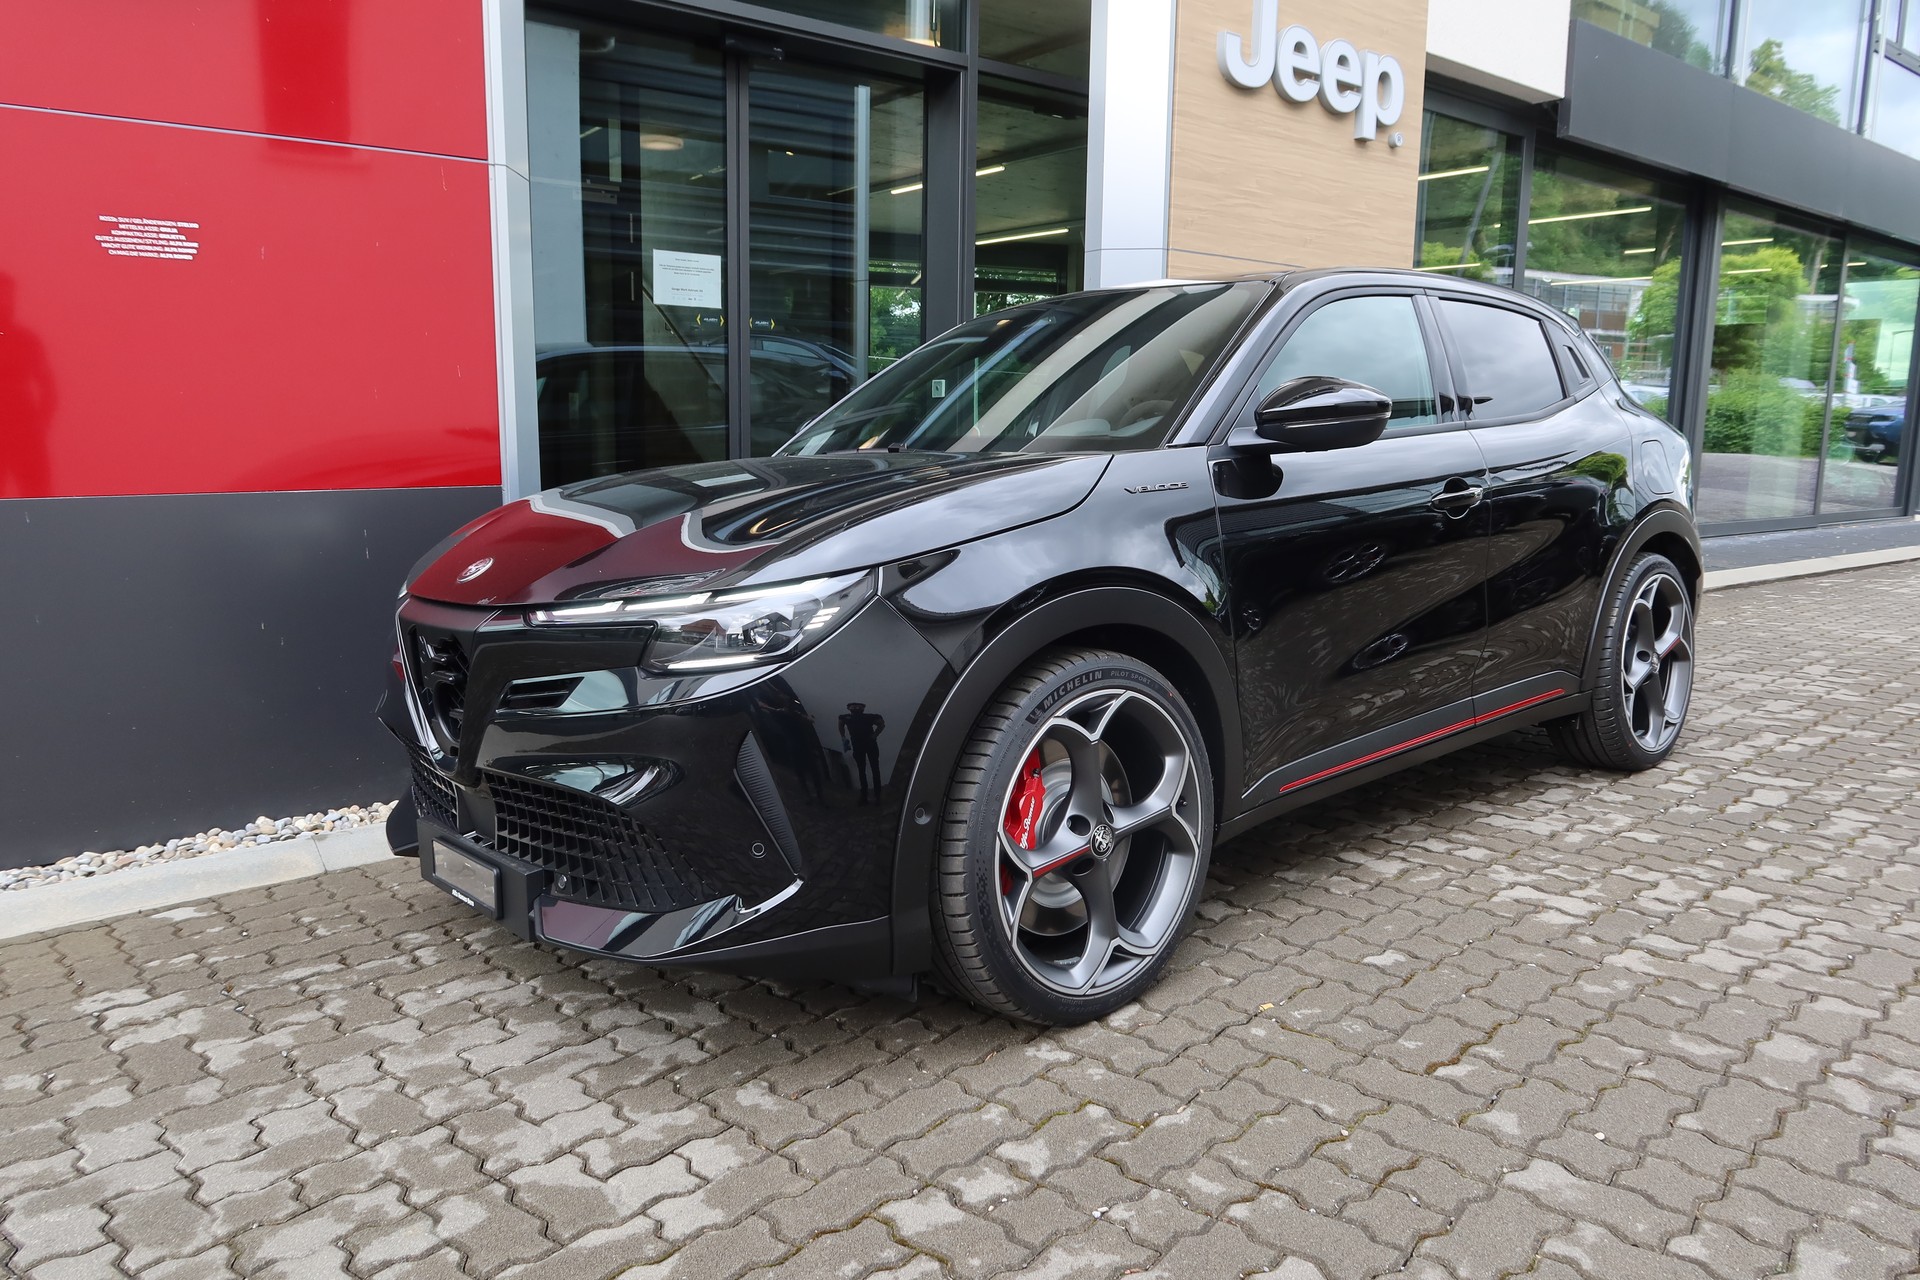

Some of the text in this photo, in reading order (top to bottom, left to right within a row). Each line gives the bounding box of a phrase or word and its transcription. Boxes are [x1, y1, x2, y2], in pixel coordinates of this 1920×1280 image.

[1217, 0, 1405, 142] Jeep
[1124, 481, 1189, 494] VELOCE
[1043, 670, 1103, 711] MICHELIN
[1110, 670, 1129, 678] PILOT
[1130, 673, 1152, 685] SPORT
